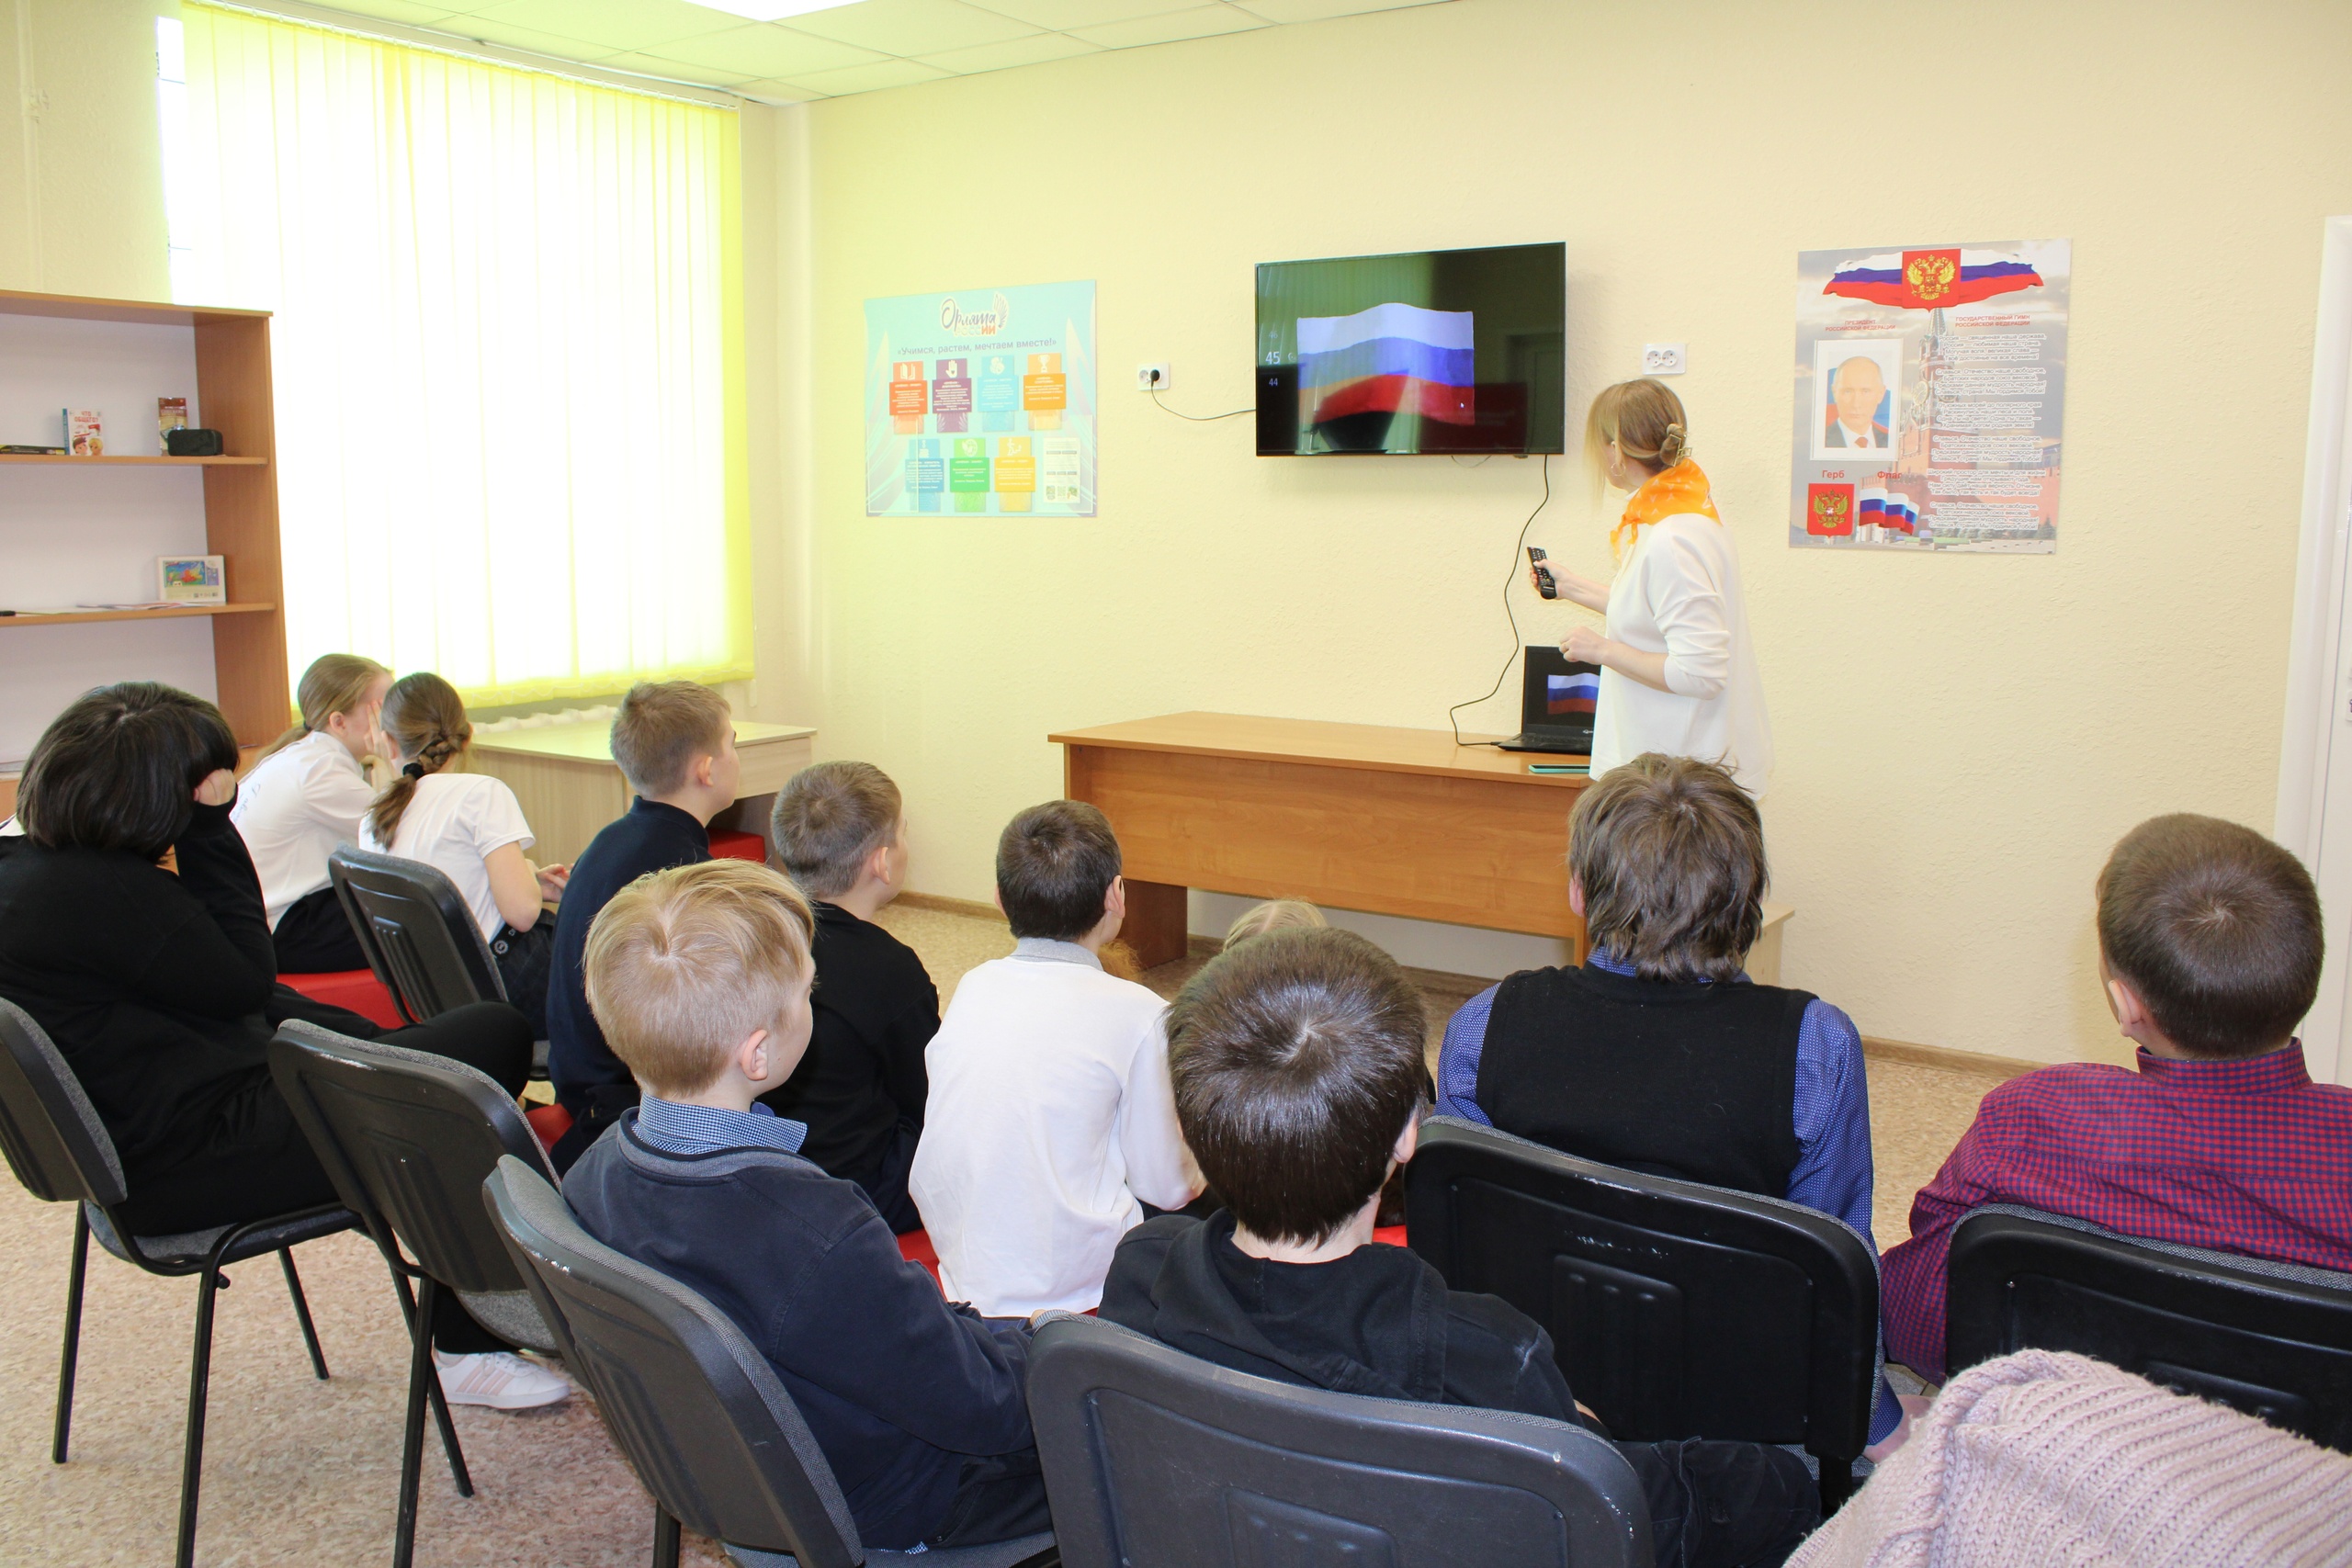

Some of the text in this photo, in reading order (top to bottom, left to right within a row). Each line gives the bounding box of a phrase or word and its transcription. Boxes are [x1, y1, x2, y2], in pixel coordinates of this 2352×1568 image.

[942, 299, 996, 331] Орлята
[938, 344, 972, 354] растем,
[975, 342, 1013, 350] мечтаем
[1017, 338, 1056, 347] вместе!»
[1266, 351, 1280, 364] 45
[1822, 470, 1844, 480] Герб
